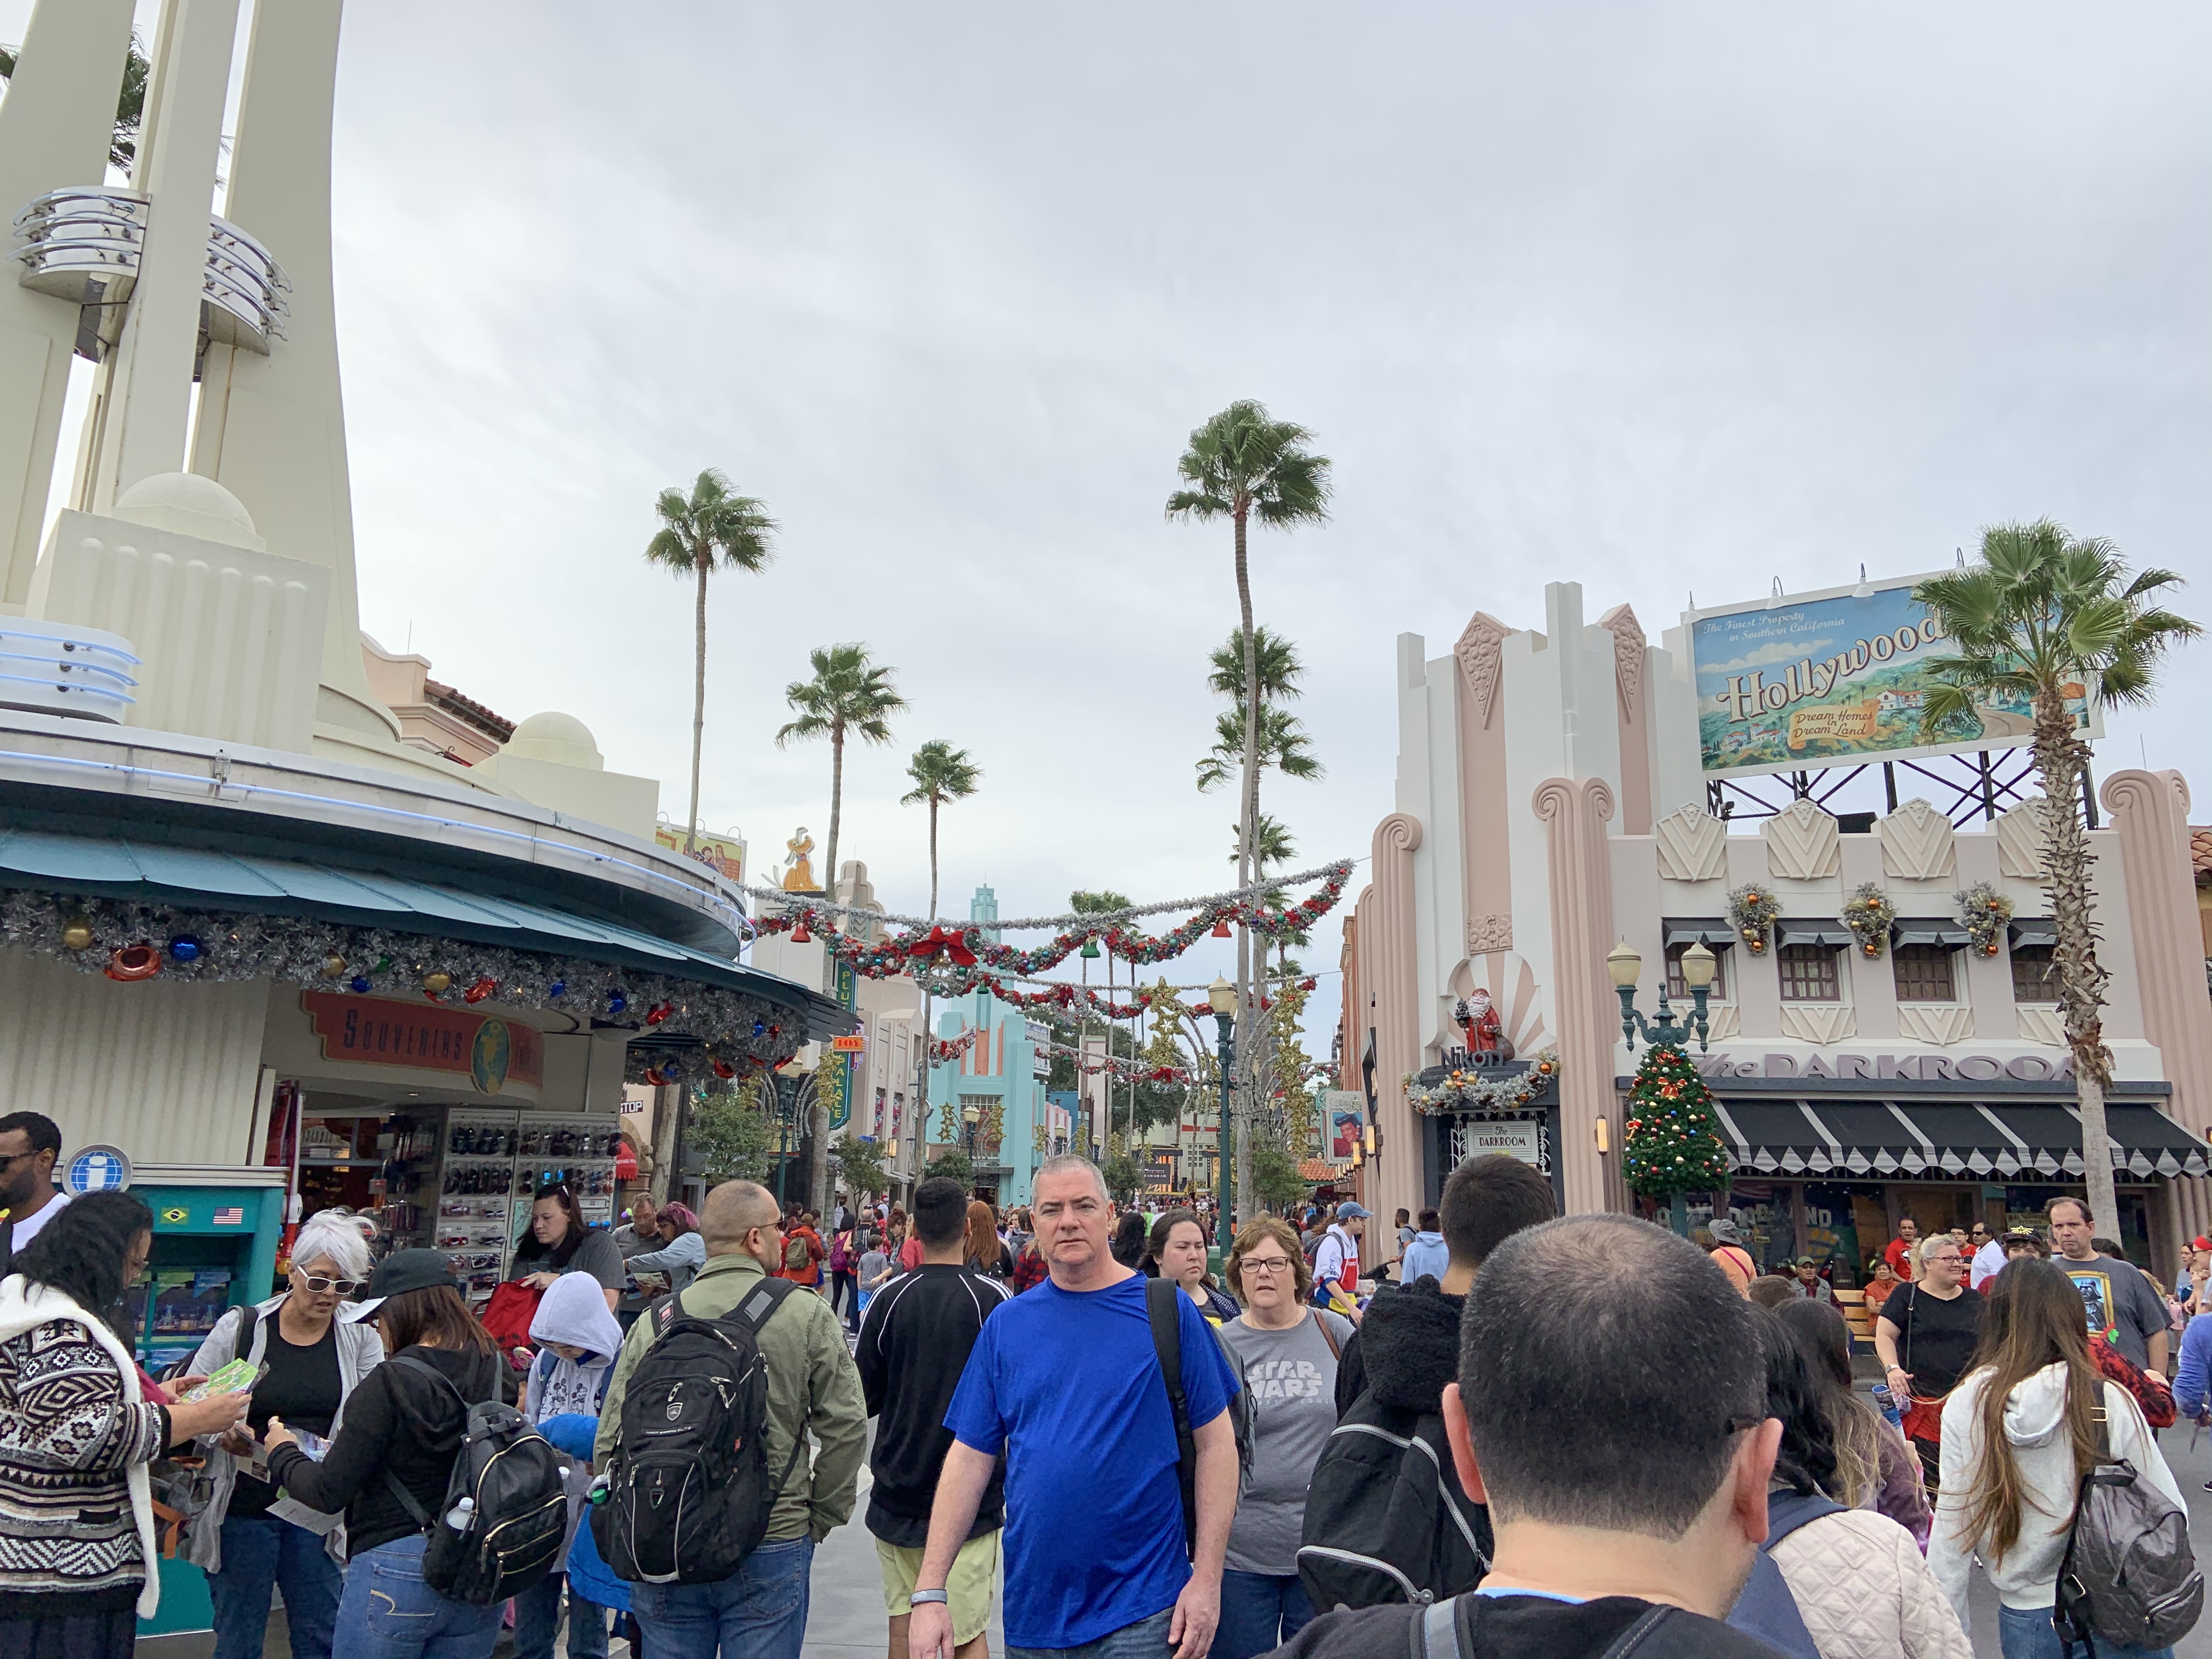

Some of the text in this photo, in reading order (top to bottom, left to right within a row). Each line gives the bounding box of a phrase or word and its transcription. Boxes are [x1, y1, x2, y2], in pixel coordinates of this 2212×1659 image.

[1703, 611, 1805, 634] The Finest Property
[1729, 617, 1845, 642] in Southern California
[1796, 709, 1874, 724] Dream Homes
[1793, 723, 1869, 738] Dream Land
[1441, 1046, 1503, 1070] Nikon
[1686, 1053, 1759, 1079] The
[1495, 1126, 1508, 1135] The
[1479, 1136, 1526, 1147] DARKROOM
[1248, 1360, 1322, 1384] STAR
[1249, 1379, 1323, 1398] WARS
